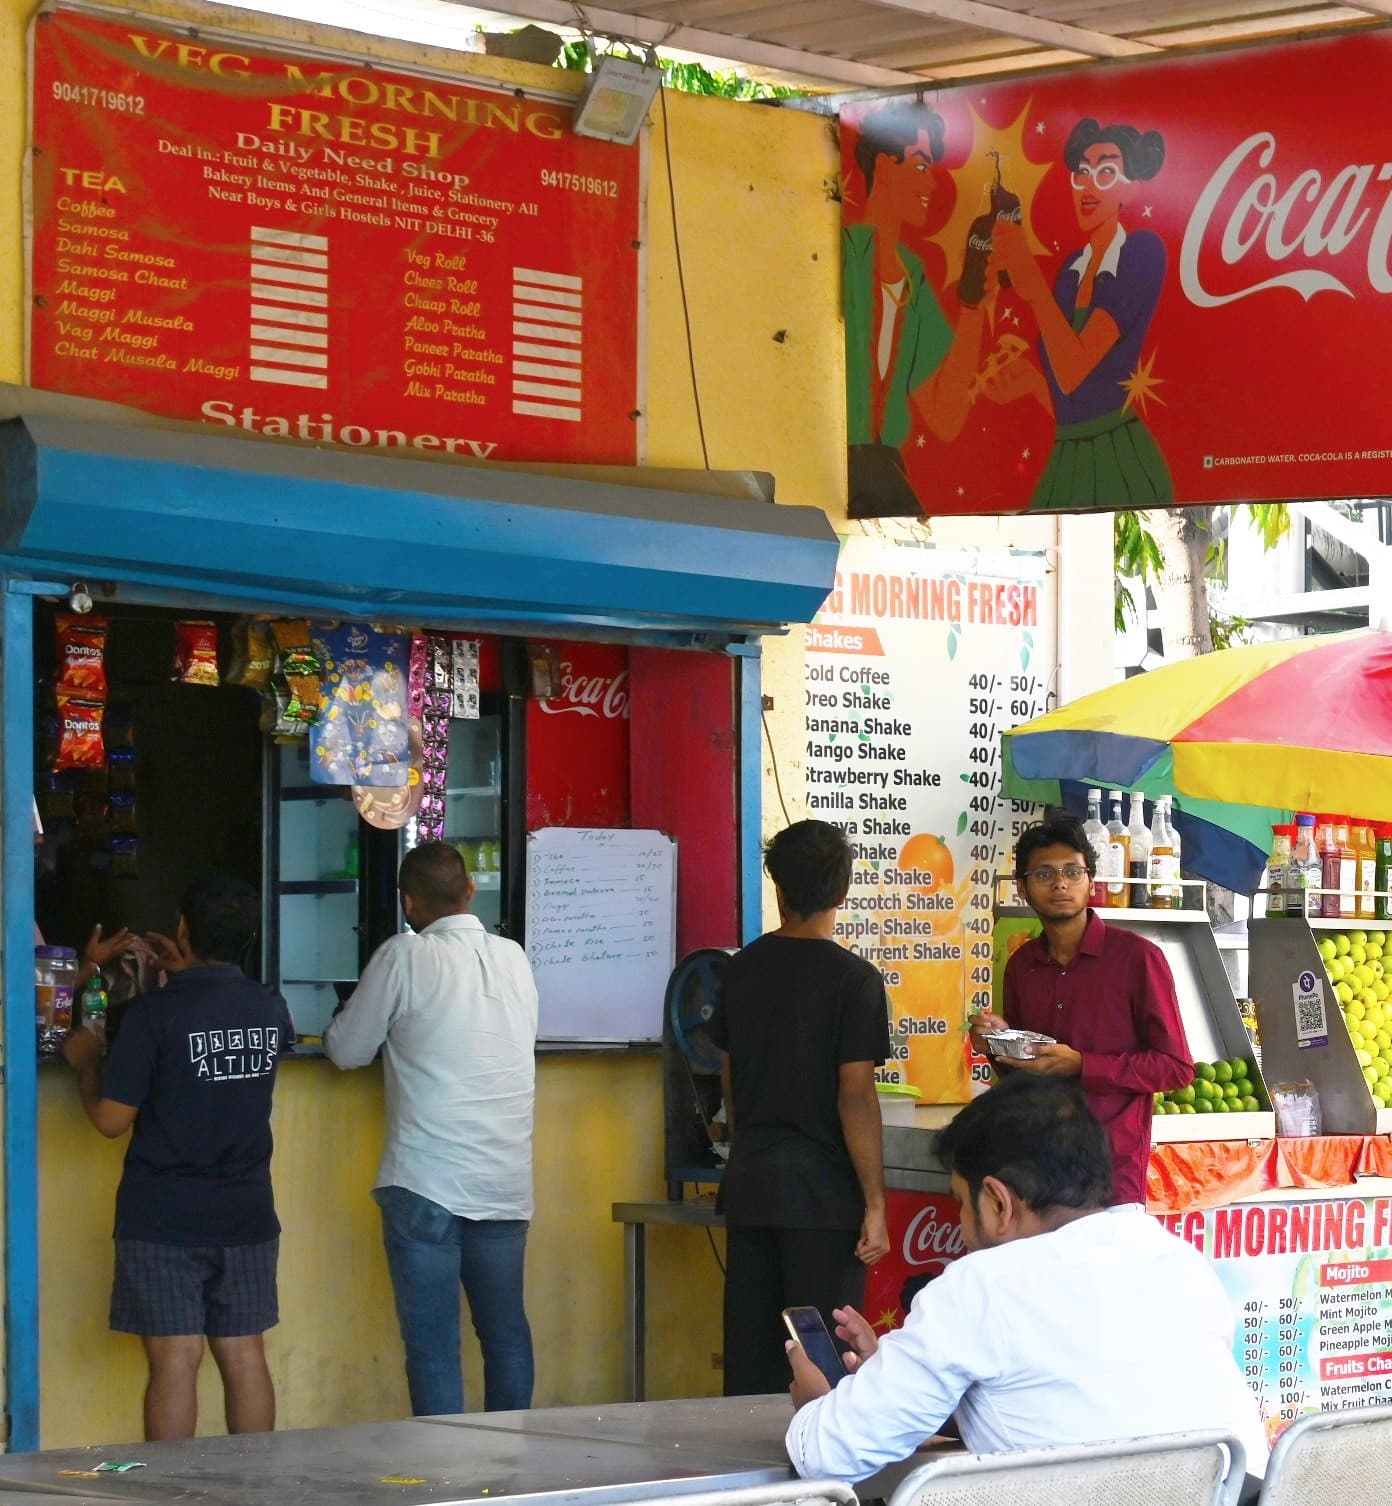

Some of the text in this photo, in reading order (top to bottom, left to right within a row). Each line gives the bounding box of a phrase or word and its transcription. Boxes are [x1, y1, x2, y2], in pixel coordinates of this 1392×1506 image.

[53, 81, 145, 115] 9041719612
[284, 64, 564, 140] MORNING
[266, 102, 443, 158] FRESH
[236, 132, 470, 190] Daily Need Shop
[60, 168, 127, 194] TEA
[159, 139, 192, 158] Deal
[224, 152, 258, 169] Fruit
[261, 158, 276, 171] &
[356, 174, 398, 192] Shake
[408, 182, 445, 202] Juice,
[448, 189, 515, 215] Stationery
[519, 203, 539, 217] All
[540, 169, 618, 198] 9417519612
[56, 197, 116, 218] Coffee
[203, 166, 500, 229] Bakery Items And General Items & Grocery
[208, 186, 495, 244] Near Boys & Girls Hostels NIT DELHI -36
[57, 218, 130, 240] Samosa
[56, 238, 177, 268] Dahi Samosa
[405, 248, 467, 272] Veg Roll
[55, 258, 189, 290] Samosa Chaat
[447, 276, 478, 295] Roll
[55, 280, 117, 302] Maggi
[55, 300, 195, 331] Maggi Musala
[403, 292, 481, 317] Chaap Roll
[403, 315, 439, 333] Aloo
[98, 326, 158, 349] Maggi
[54, 341, 240, 380] Chat Musala Maggi
[452, 343, 504, 365] Paratha
[403, 359, 496, 385] Gobhi Paratha
[403, 381, 486, 405] Mix Paratha
[1214, 456, 1266, 466] CARBONATED
[1344, 451, 1353, 460] IS
[1354, 451, 1360, 460] A
[851, 572, 961, 622] MORNING
[968, 582, 1037, 627] FRESH
[64, 644, 102, 657] Doritos
[839, 666, 1043, 694] Coffee 40/- 50/-
[842, 691, 1043, 719] Shake 50/- 60/-
[64, 719, 100, 731] Doritos
[864, 718, 912, 736] Shake
[969, 722, 1003, 742] 40/-
[858, 742, 906, 761] Shake
[893, 769, 941, 787] Shake
[858, 793, 907, 811] Shake
[969, 796, 1003, 815] 40/-
[862, 818, 911, 836] Shake
[970, 820, 1004, 839] 40/-
[850, 843, 1004, 863] Shake 40/-
[883, 868, 932, 885] Shake
[906, 893, 954, 910] Shake
[883, 918, 932, 935] Shake
[913, 942, 961, 960] Shake
[898, 1017, 946, 1034] Shake
[198, 1053, 273, 1077] ALTIUS
[1213, 1199, 1365, 1260] MORNING
[1326, 1264, 1369, 1282] Mojito
[1244, 1300, 1268, 1313] 40/-
[1279, 1297, 1303, 1310] 50/-
[1319, 1290, 1381, 1304] Watermelon
[1244, 1316, 1268, 1329] 50/-
[1279, 1313, 1302, 1325] 60/-
[1320, 1307, 1342, 1320] Mint
[1345, 1306, 1377, 1319] Mojito
[1244, 1332, 1268, 1345] 40/-
[1279, 1328, 1302, 1341] 50/-
[1319, 1325, 1349, 1335] Green
[1352, 1321, 1381, 1333] Apple
[1245, 1348, 1268, 1360] 50/-
[1279, 1344, 1302, 1357] 60/-
[1319, 1337, 1369, 1351] Pineapple
[1245, 1364, 1269, 1376] 50/-
[1279, 1360, 1303, 1373] 60/-
[1325, 1361, 1364, 1376] Fruits
[1279, 1376, 1303, 1388] 60/-
[1320, 1381, 1382, 1397] Watermelon
[1280, 1391, 1310, 1404] 100/-
[1321, 1400, 1338, 1412] Mix
[1280, 1407, 1303, 1420] 50/-
